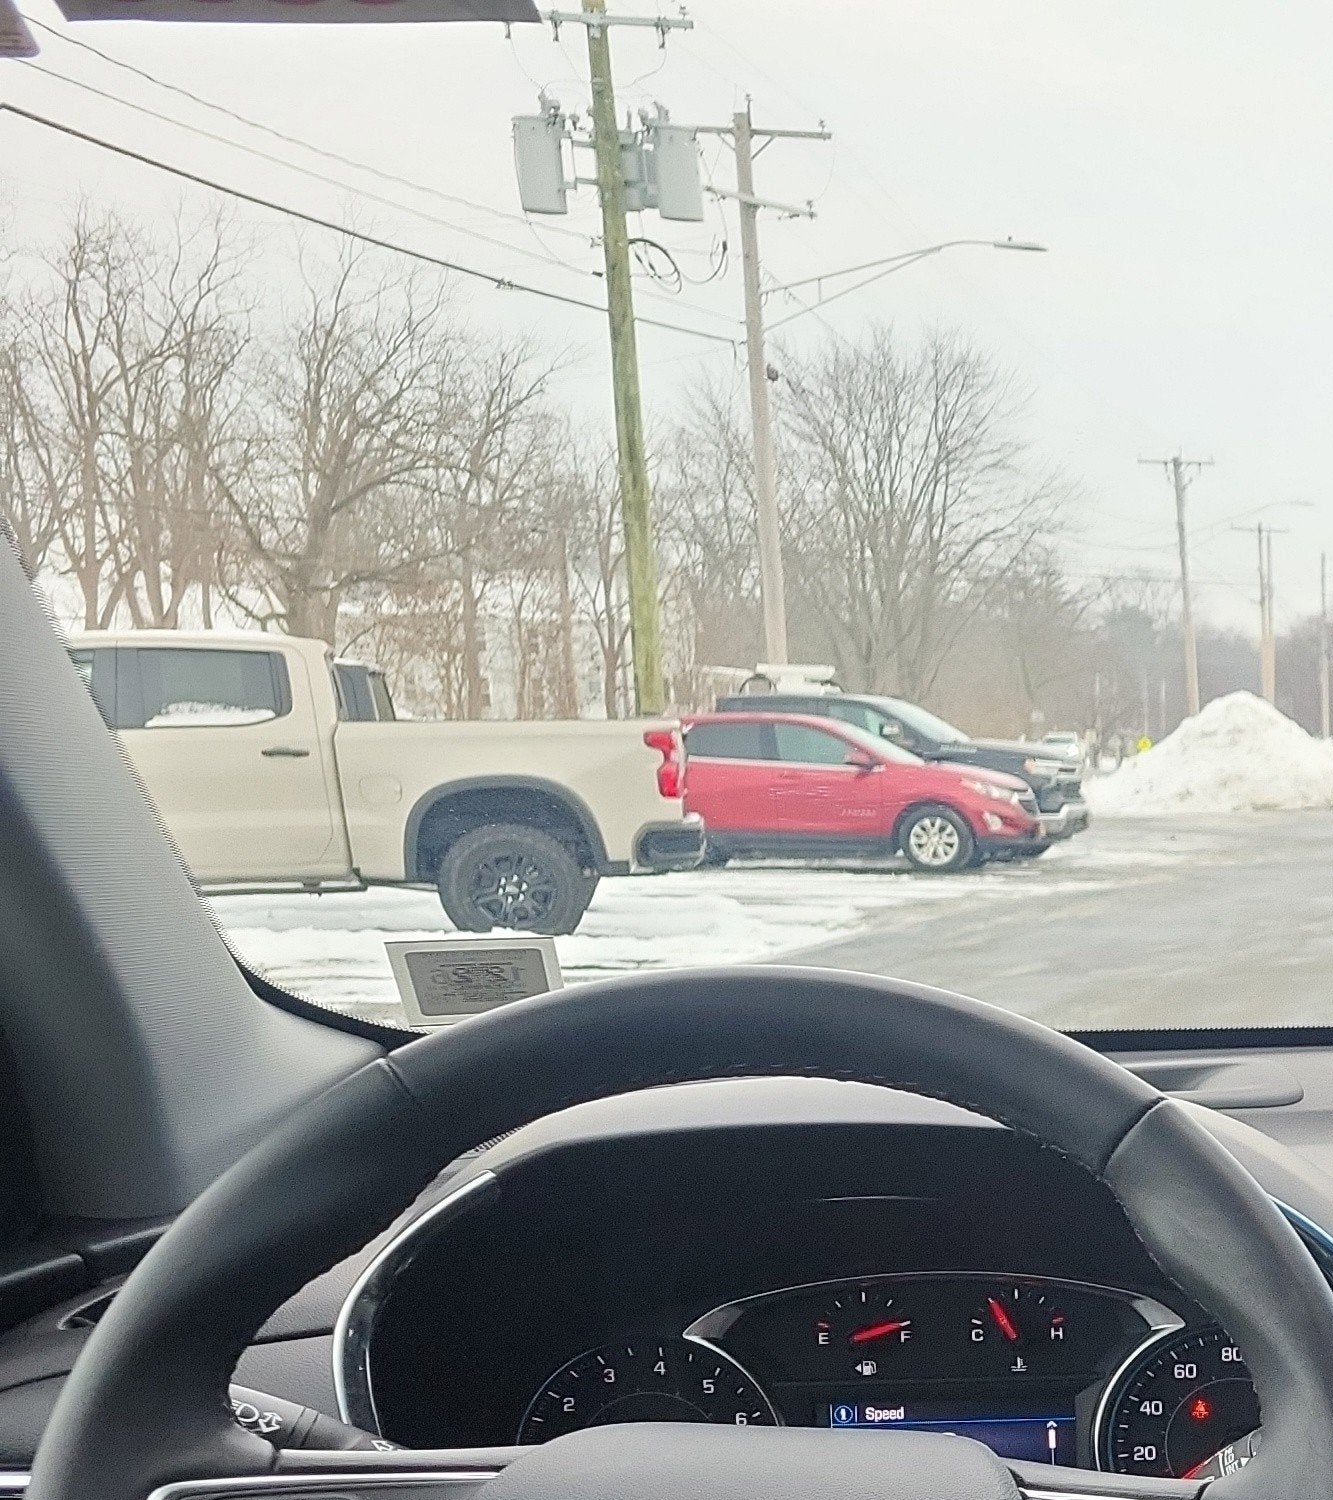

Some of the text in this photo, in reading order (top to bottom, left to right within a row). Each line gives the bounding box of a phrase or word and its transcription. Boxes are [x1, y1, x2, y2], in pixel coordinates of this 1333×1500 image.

[818, 1330, 912, 1345] E F
[971, 1327, 1064, 1342] C H
[603, 1368, 616, 1383] 3
[653, 1361, 666, 1376] 4
[1173, 1363, 1197, 1379] 60
[702, 1379, 715, 1394] 5
[563, 1397, 576, 1412] 2
[1139, 1400, 1163, 1416] 40
[735, 1412, 748, 1426] 6
[865, 1406, 905, 1423] Speed
[1133, 1445, 1156, 1461] 20
